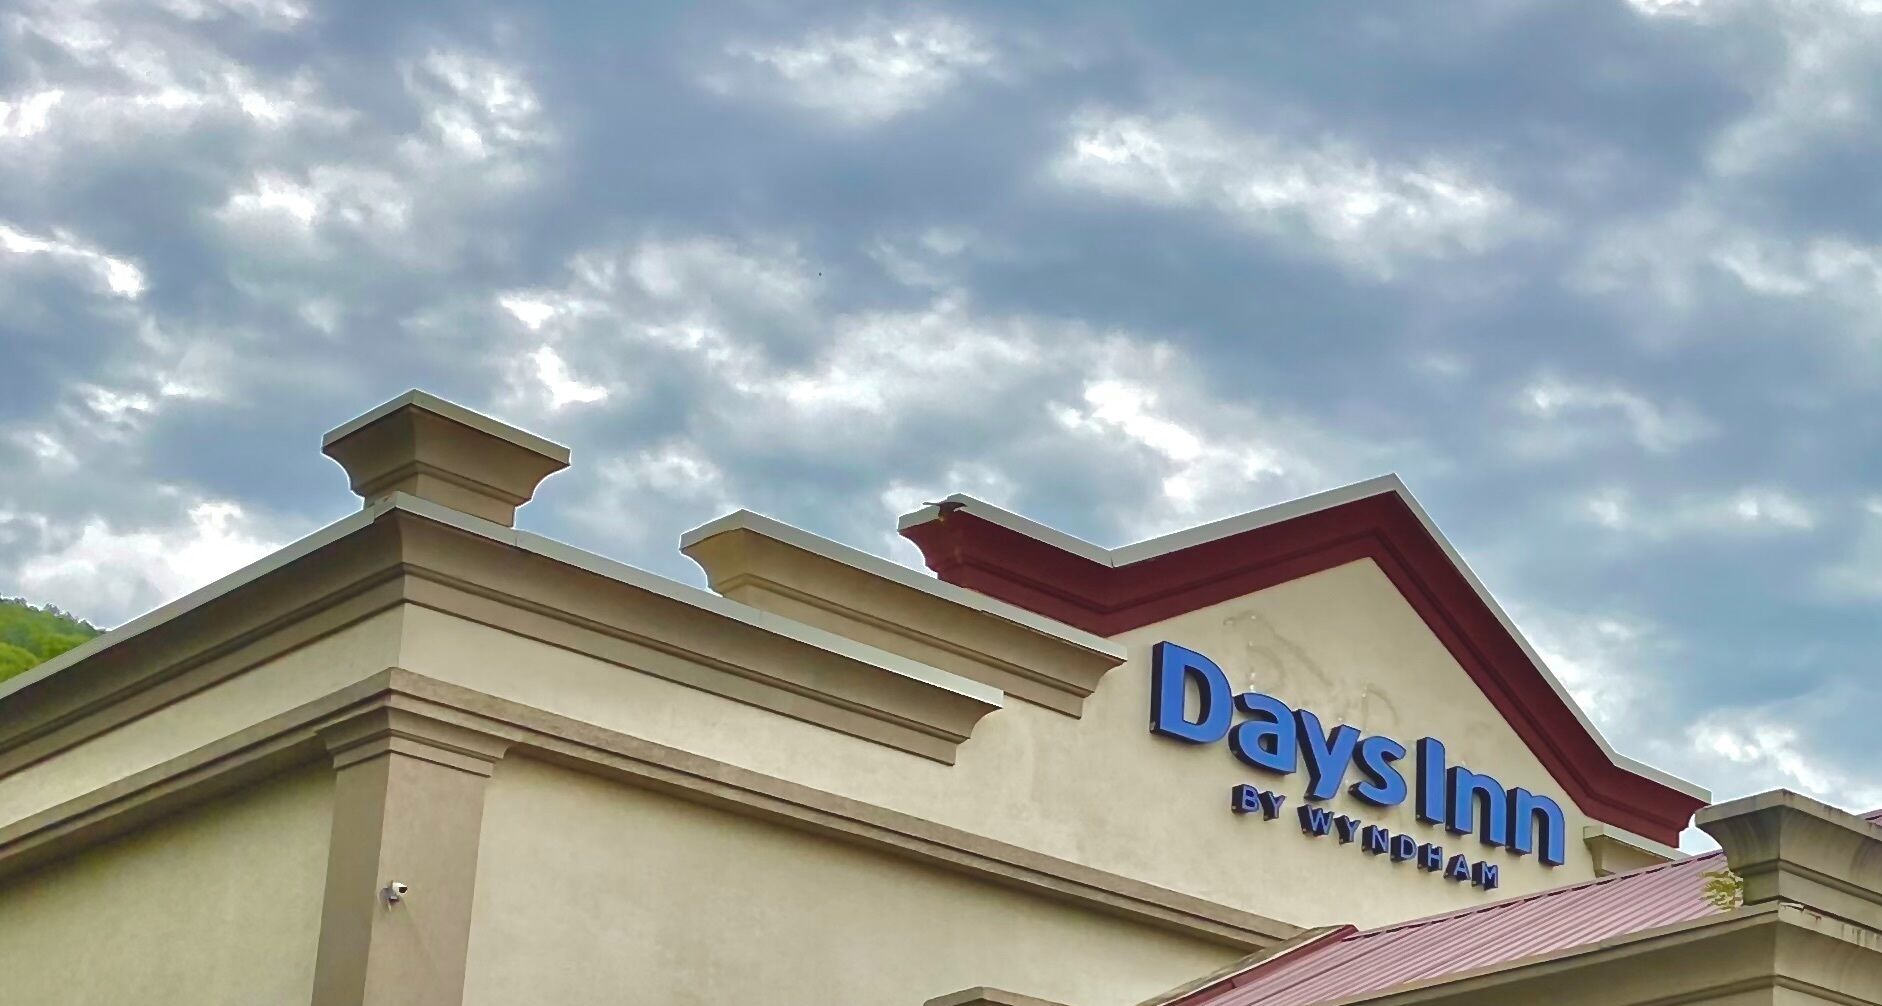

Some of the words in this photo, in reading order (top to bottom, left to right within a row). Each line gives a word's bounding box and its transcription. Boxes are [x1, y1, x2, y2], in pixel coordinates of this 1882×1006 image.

[1149, 640, 1407, 806] Days
[1416, 736, 1565, 867] Inn
[1231, 783, 1287, 821] BY
[1297, 804, 1499, 891] WYNDHAM
